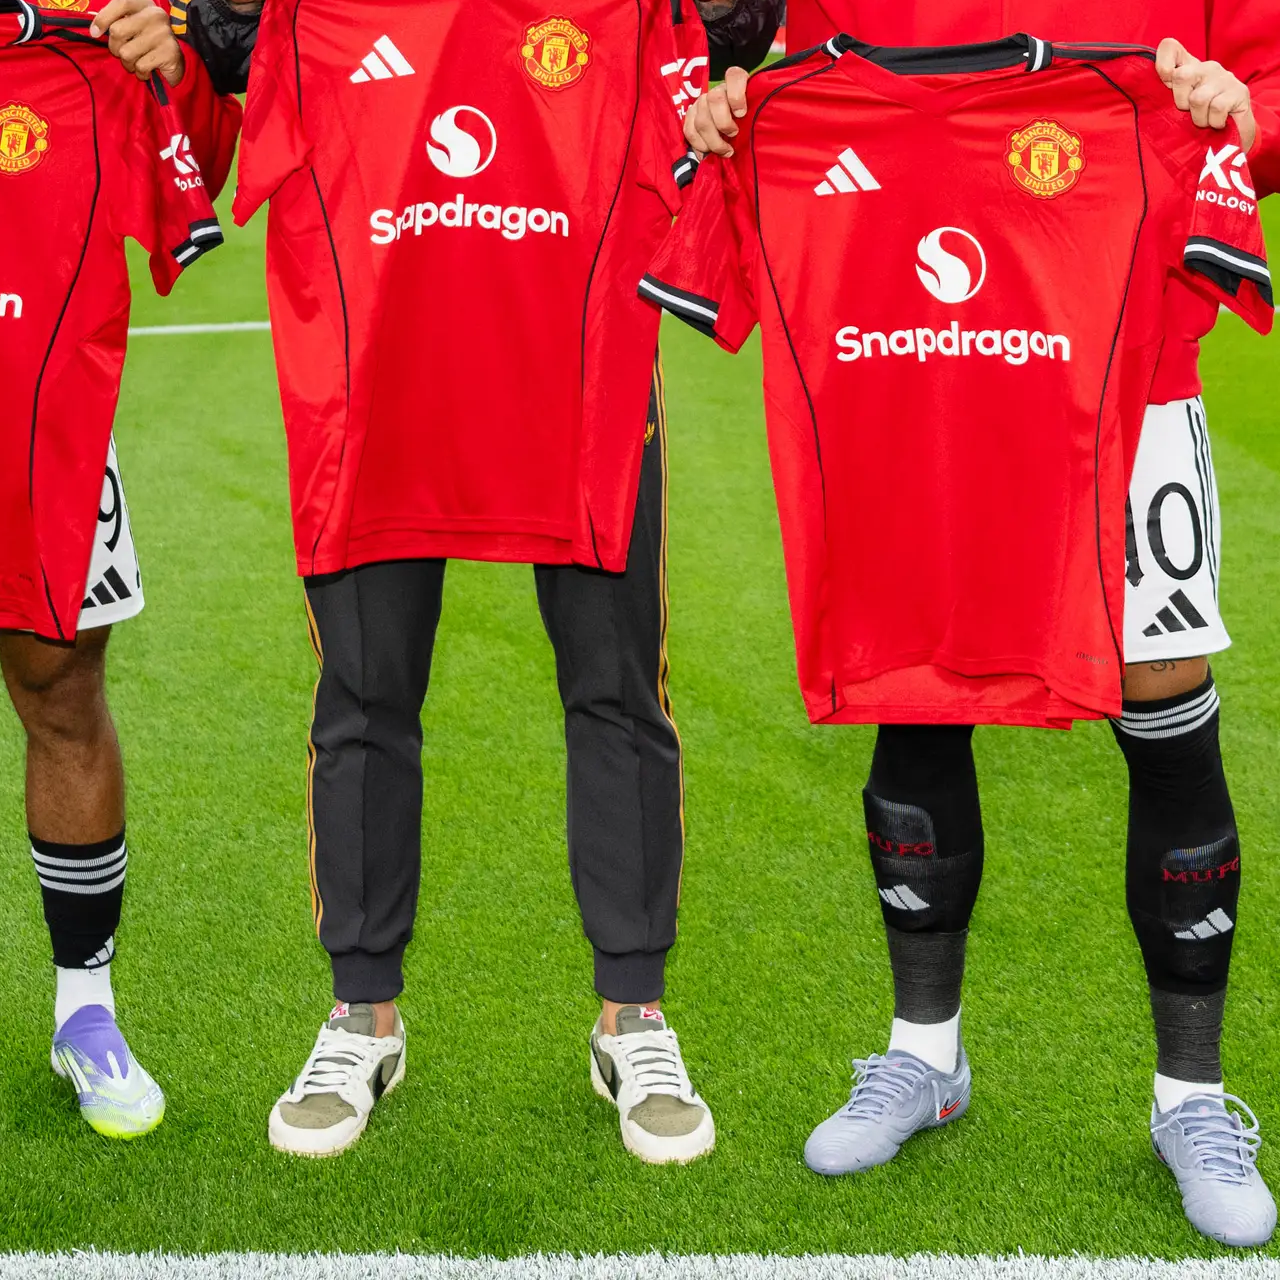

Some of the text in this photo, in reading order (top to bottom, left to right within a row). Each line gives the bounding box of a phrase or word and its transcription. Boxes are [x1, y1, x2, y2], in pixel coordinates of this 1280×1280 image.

[531, 23, 584, 48] MANCHESTER
[534, 67, 571, 82] UNITED
[1016, 127, 1075, 152] MANCHESTER
[1024, 176, 1065, 191] UNITED
[1195, 190, 1255, 216] NOLOGY
[835, 320, 1071, 365] Snapdragon
